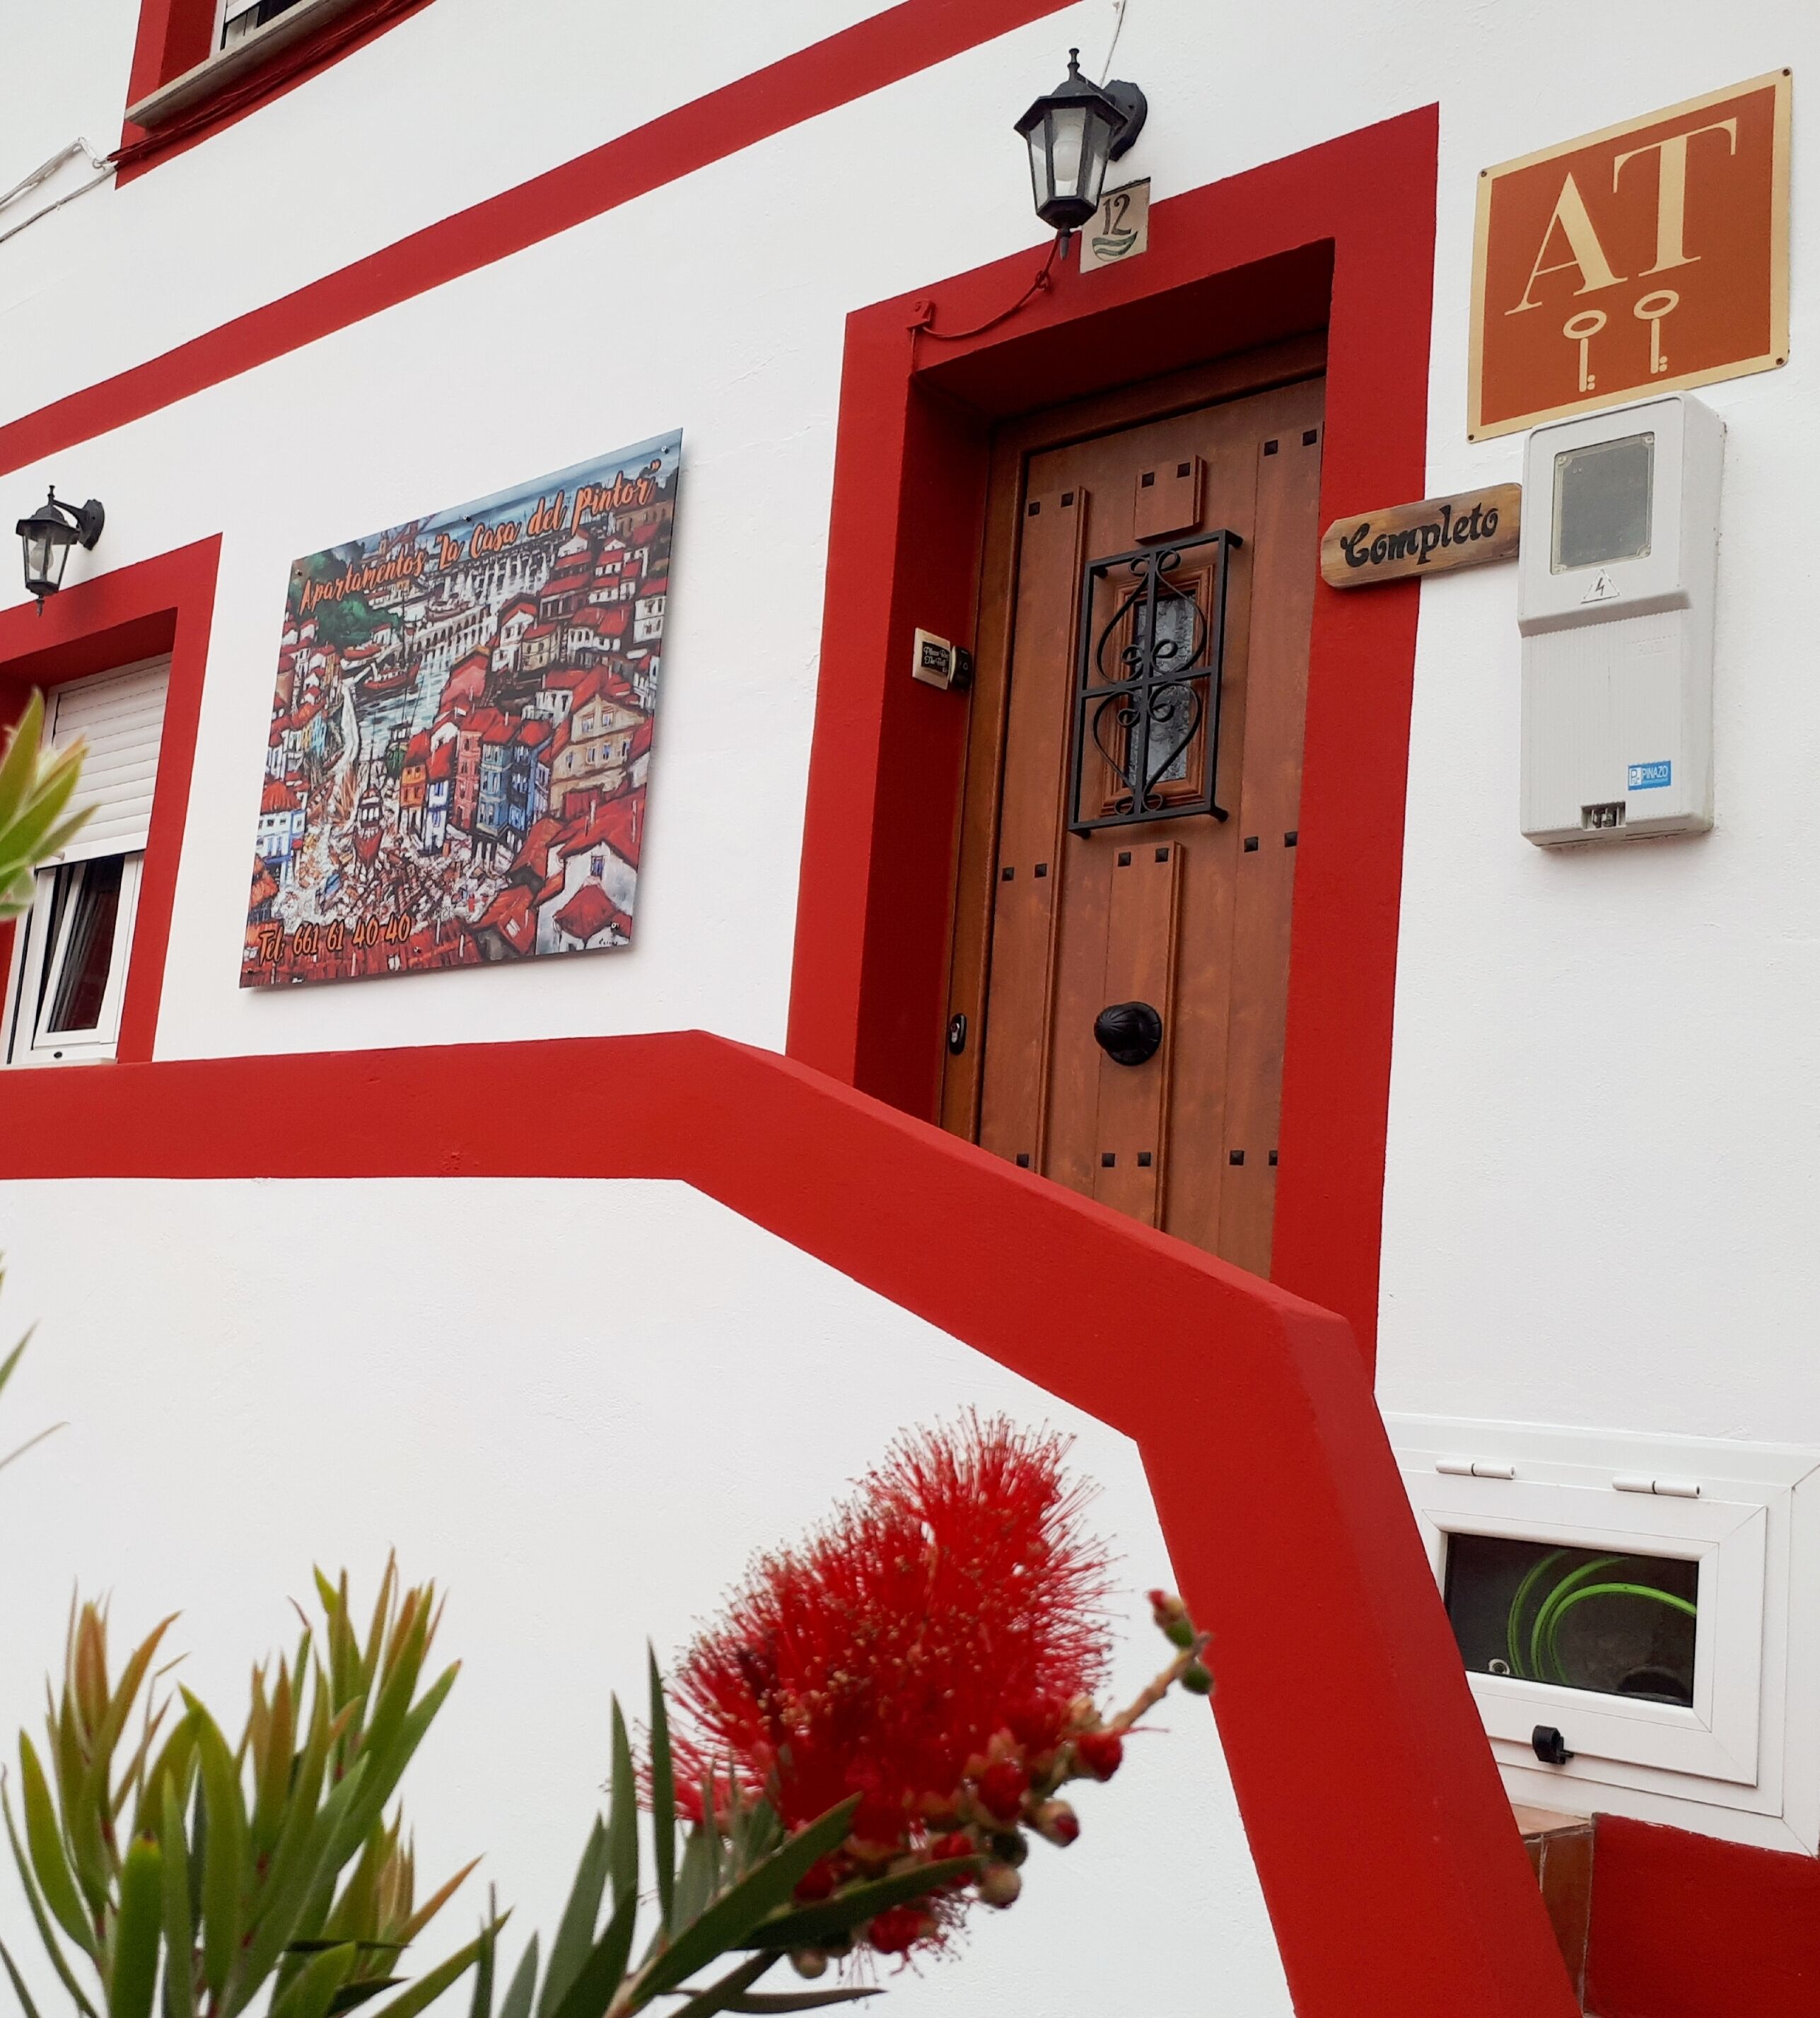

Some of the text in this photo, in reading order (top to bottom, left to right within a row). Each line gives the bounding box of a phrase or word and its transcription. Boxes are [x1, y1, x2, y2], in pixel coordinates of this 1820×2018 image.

[1102, 194, 1131, 235] 12
[1505, 117, 1737, 315] AT
[299, 550, 426, 615] Apartamentos
[469, 520, 520, 558] Casa
[527, 491, 564, 536] del
[1339, 502, 1498, 567] Completo
[1642, 765, 1668, 778] PINAZO
[293, 923, 318, 955] 661
[327, 921, 345, 951] 61
[353, 916, 379, 949] 40
[384, 911, 411, 945] 40
